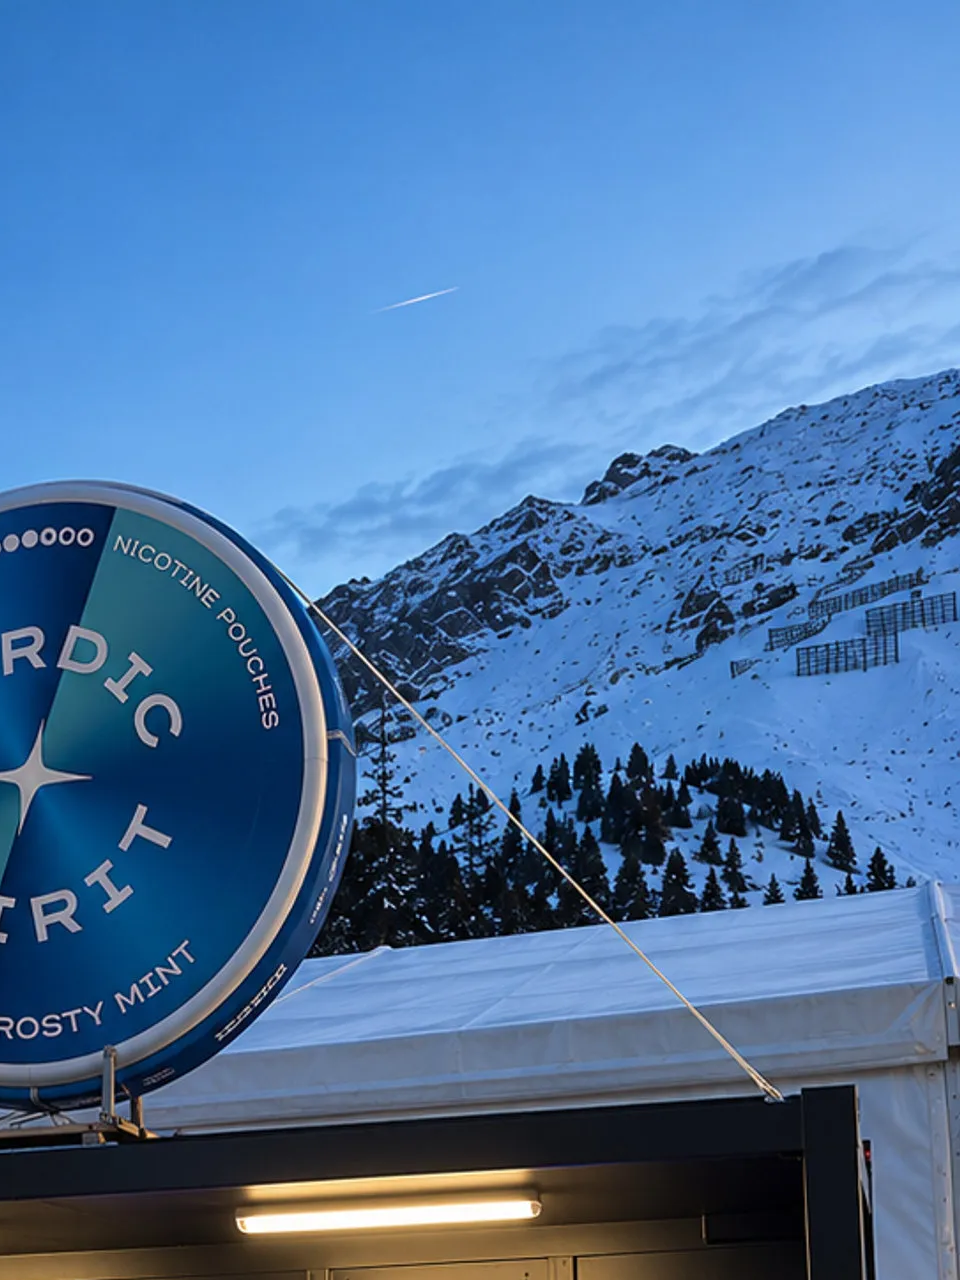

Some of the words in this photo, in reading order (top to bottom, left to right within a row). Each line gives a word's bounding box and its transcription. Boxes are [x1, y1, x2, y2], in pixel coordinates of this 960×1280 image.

[113, 534, 220, 608] NICOTINE
[216, 607, 279, 730] POUCHES
[115, 940, 196, 1014] MINT
